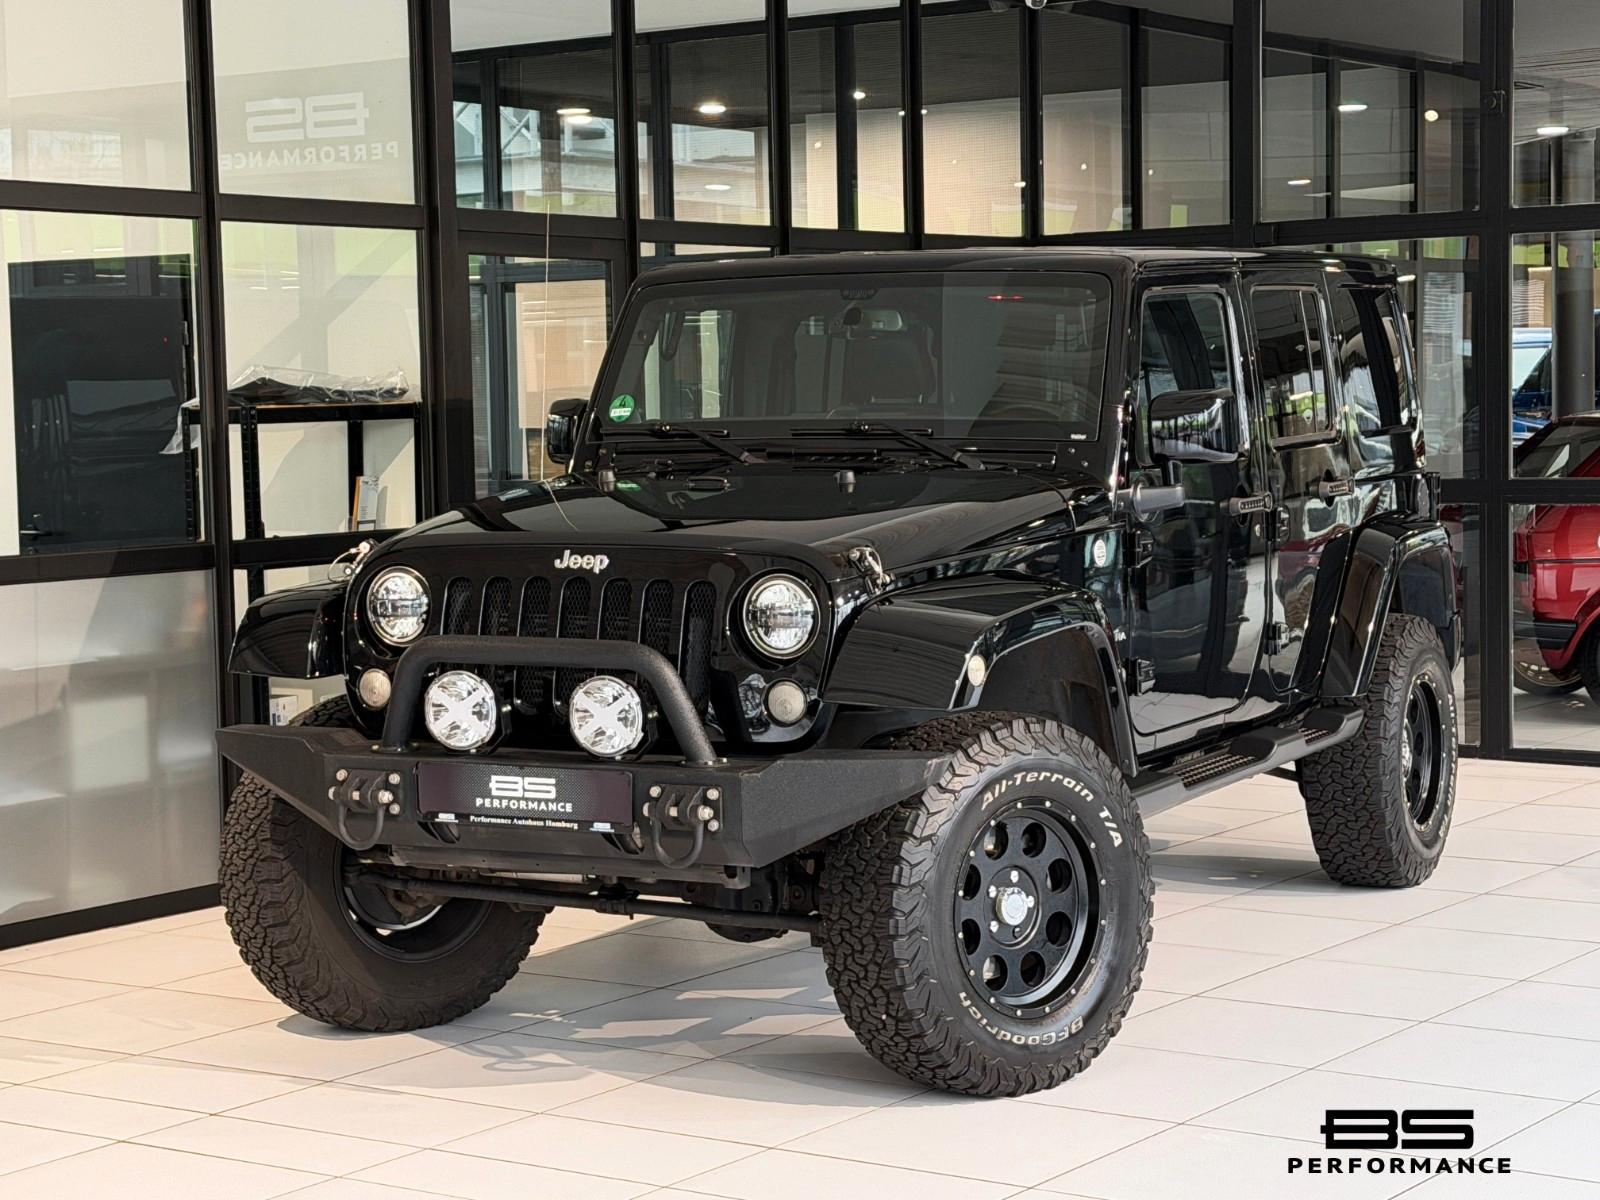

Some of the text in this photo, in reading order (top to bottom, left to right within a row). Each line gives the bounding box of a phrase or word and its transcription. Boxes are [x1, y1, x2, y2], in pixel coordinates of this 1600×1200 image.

[618, 395, 627, 407] 4
[554, 549, 610, 574] Jeep
[489, 775, 556, 799] BS
[475, 797, 573, 813] PERFORMANCE
[981, 771, 1123, 848] All-Terrain T/A
[470, 815, 578, 830] Performance Autohaus Hamburg
[959, 992, 1083, 1046] BFGoodrich
